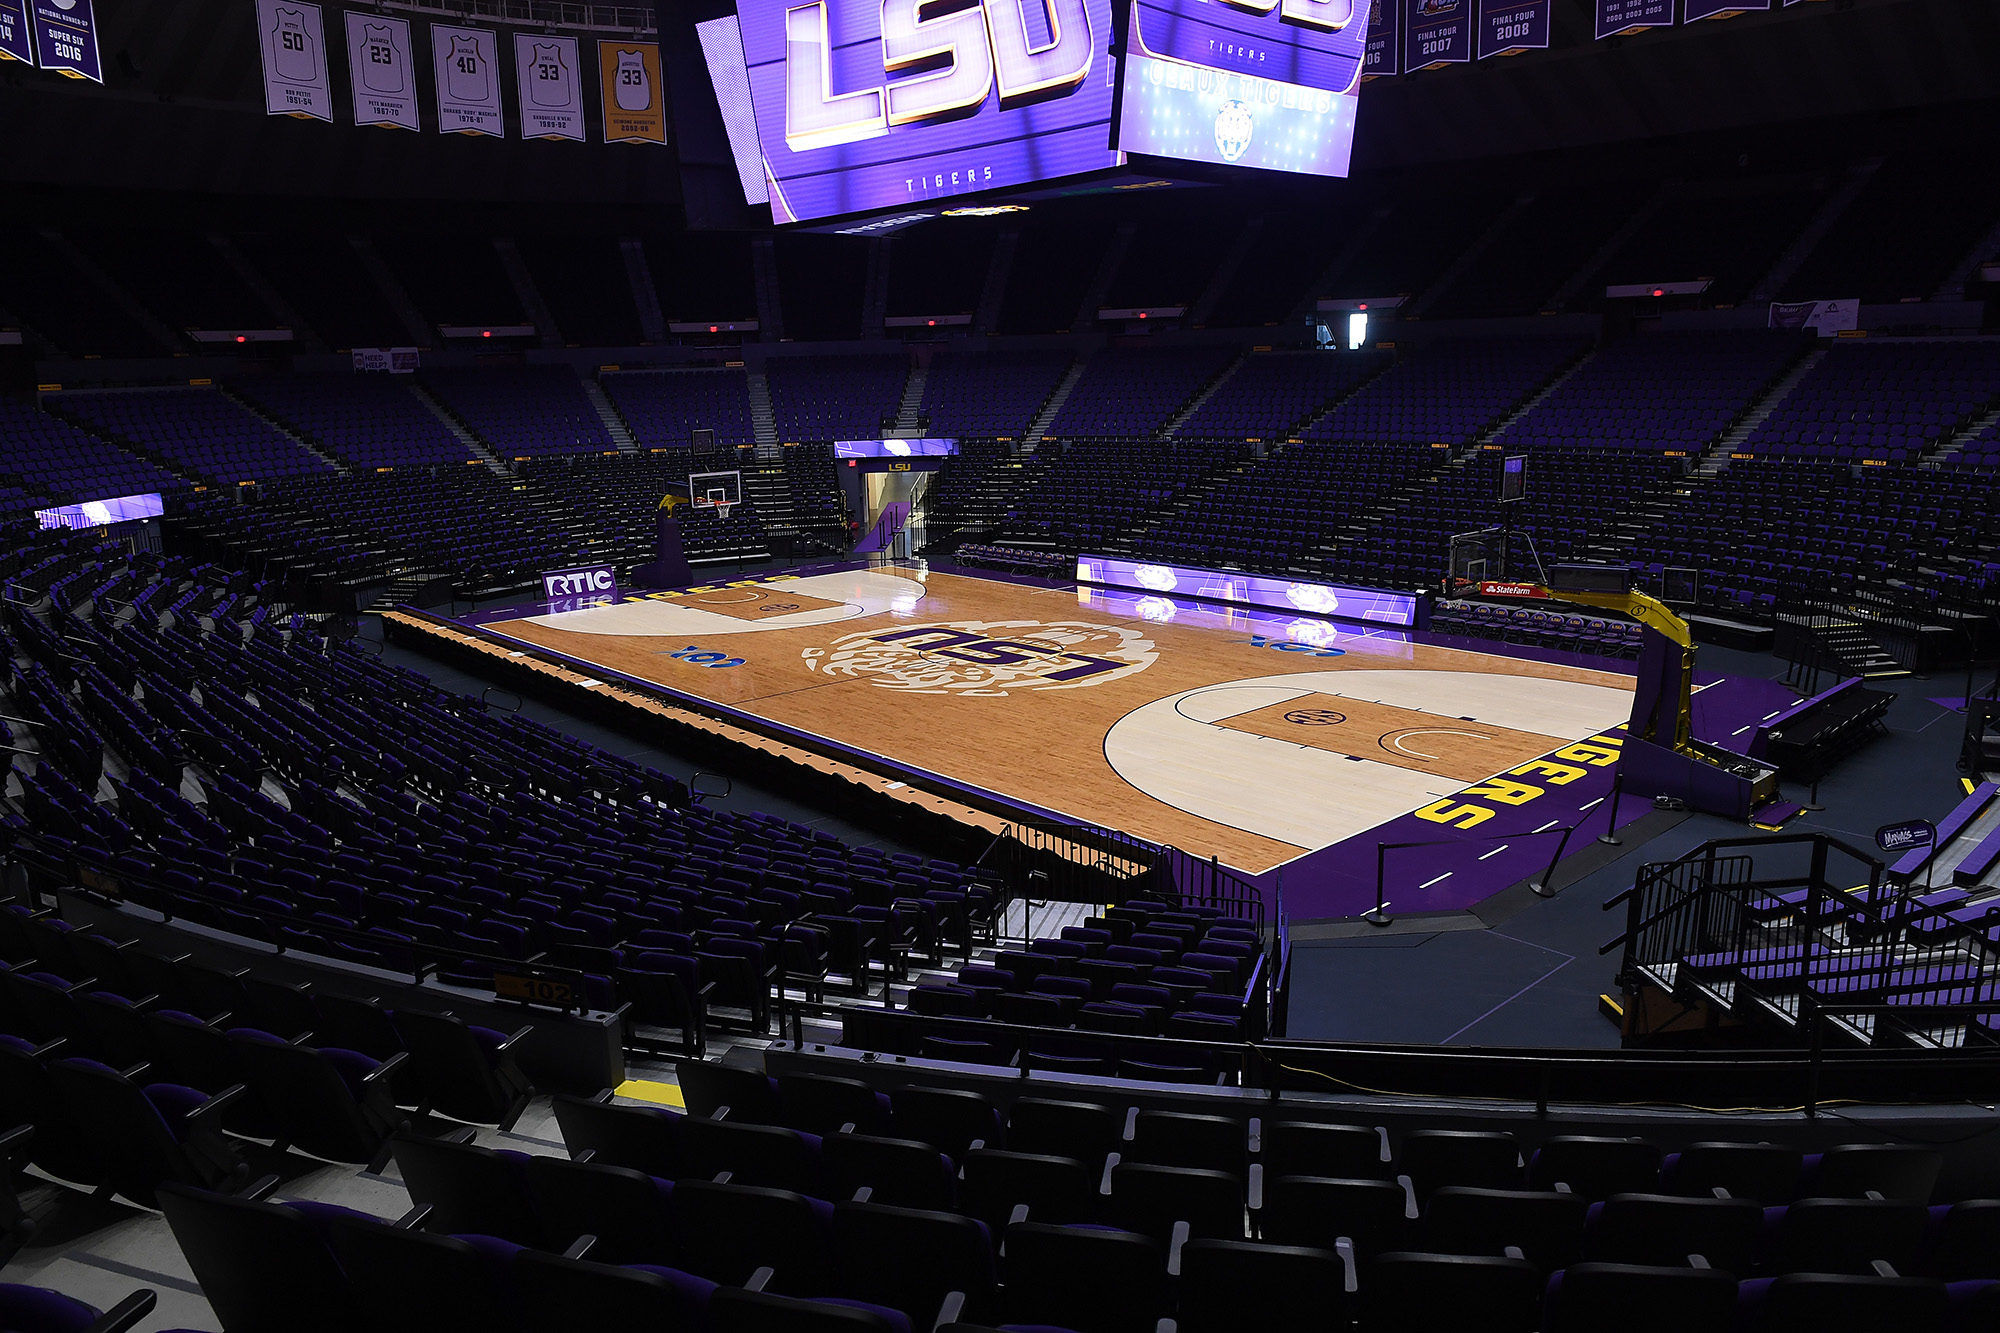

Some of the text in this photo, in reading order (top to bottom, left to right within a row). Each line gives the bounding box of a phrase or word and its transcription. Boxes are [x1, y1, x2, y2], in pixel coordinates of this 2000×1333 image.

[2, 13, 15, 25] SIX
[1492, 10, 1535, 26] FINAL FOUR
[1625, 9, 1643, 19] 2003
[48, 28, 85, 47] SUPER SIX
[282, 30, 304, 51] 50
[1418, 26, 1457, 41] FINAL FOUR
[1496, 22, 1530, 41] 2008
[54, 42, 82, 62] 2016
[370, 45, 391, 64] 23
[1209, 40, 1266, 61] TIGERS
[1368, 41, 1385, 50] FOUR
[1422, 38, 1452, 55] 2007
[457, 56, 476, 74] 40
[538, 64, 559, 81] 33
[621, 69, 642, 85] 33
[785, 0, 1095, 152] LSU
[285, 96, 312, 106] 1951-54
[373, 107, 399, 116] 1967-70
[458, 115, 484, 124] 1976-81
[905, 166, 992, 192] TIGERS
[365, 361, 387, 369] HELP?
[546, 570, 612, 596] RTIC
[866, 627, 1134, 683] LSU
[1414, 724, 1629, 830] IGERS
[523, 980, 571, 1002] 102
